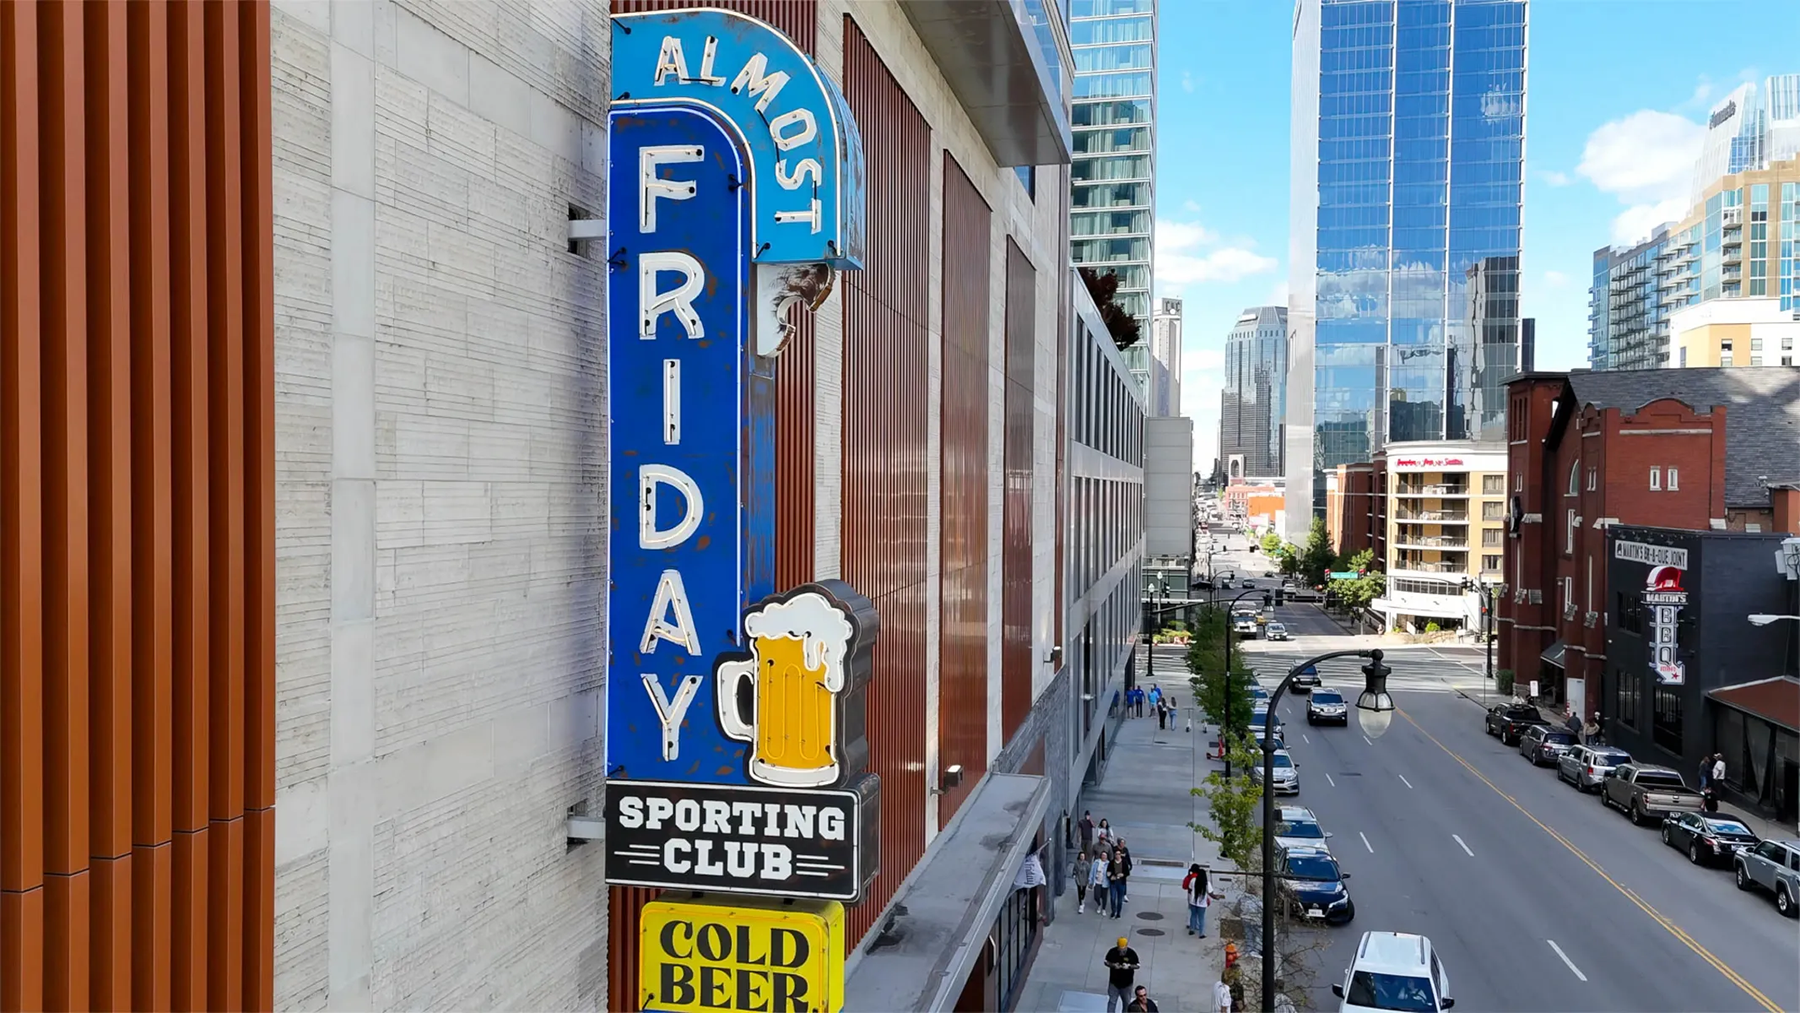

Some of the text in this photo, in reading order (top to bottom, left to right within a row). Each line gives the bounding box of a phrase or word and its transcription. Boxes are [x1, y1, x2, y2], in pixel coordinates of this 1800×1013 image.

[654, 36, 822, 234] ALMOST
[639, 145, 706, 762] FRIDAY
[1660, 608, 1672, 666] BBQ
[619, 796, 845, 840] SPORTING
[664, 838, 792, 880] CLUB
[660, 920, 810, 968] COLD
[660, 962, 809, 1013] BEER
